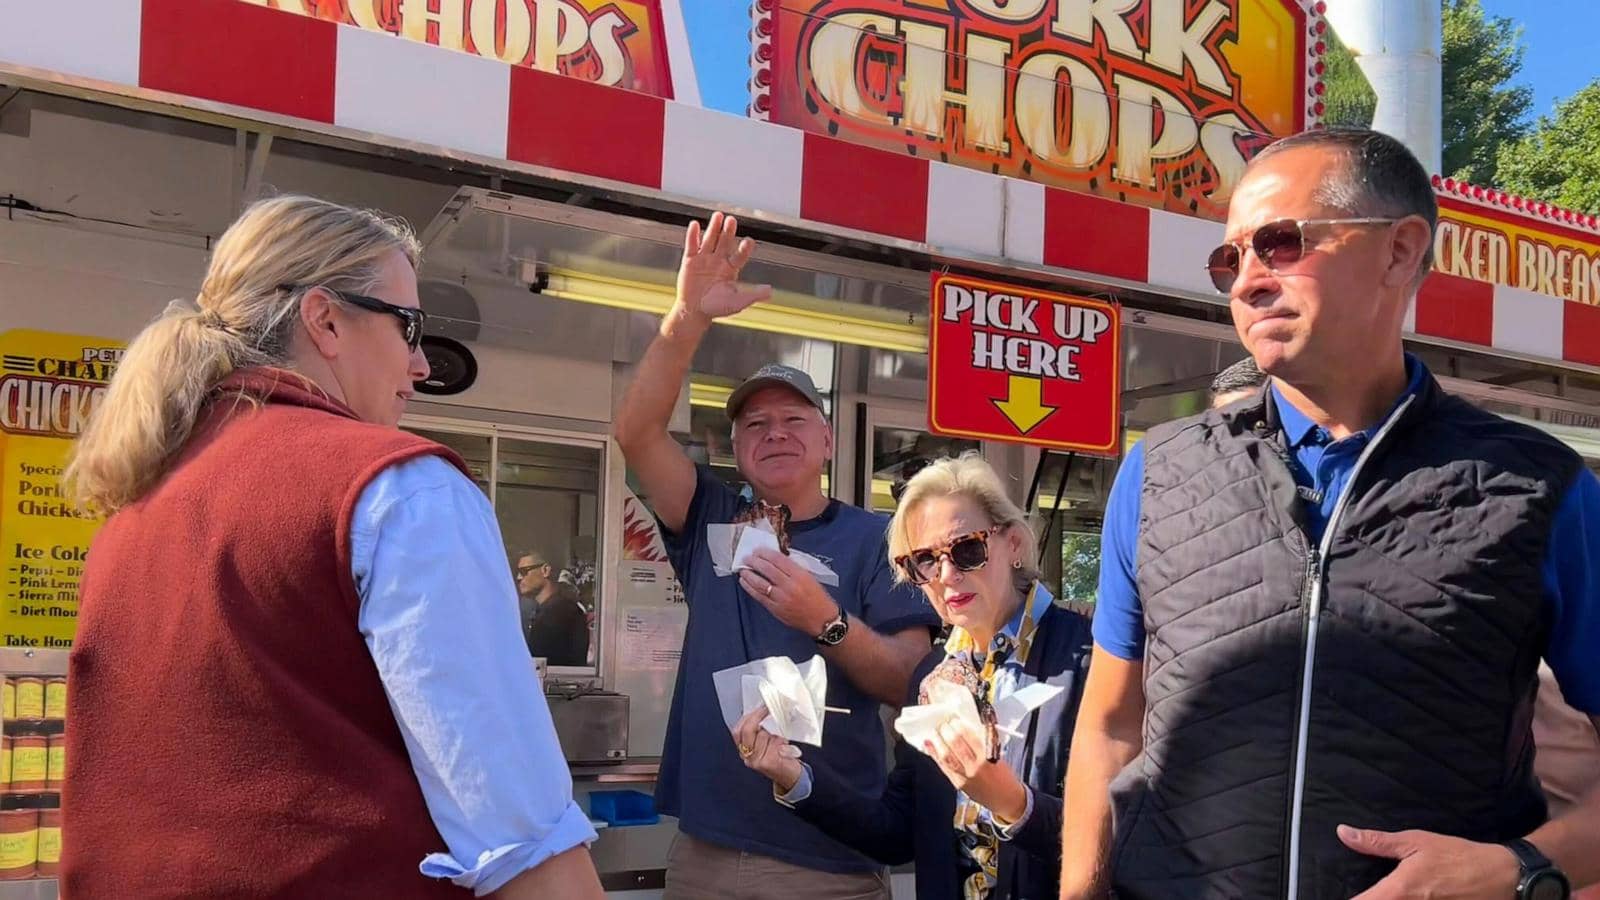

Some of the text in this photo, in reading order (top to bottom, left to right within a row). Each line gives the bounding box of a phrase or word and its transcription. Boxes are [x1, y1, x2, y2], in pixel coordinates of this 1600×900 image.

[961, 0, 1232, 96] RK
[809, 12, 1256, 200] CHOPS
[943, 284, 1111, 343] PICK UP
[972, 331, 1081, 380] HERE
[15, 543, 44, 559] Ice
[21, 564, 53, 576] Pepsi
[20, 577, 47, 588] Pink
[19, 589, 54, 600] Sierra
[21, 606, 46, 616] Diet
[4, 634, 39, 647] Take
